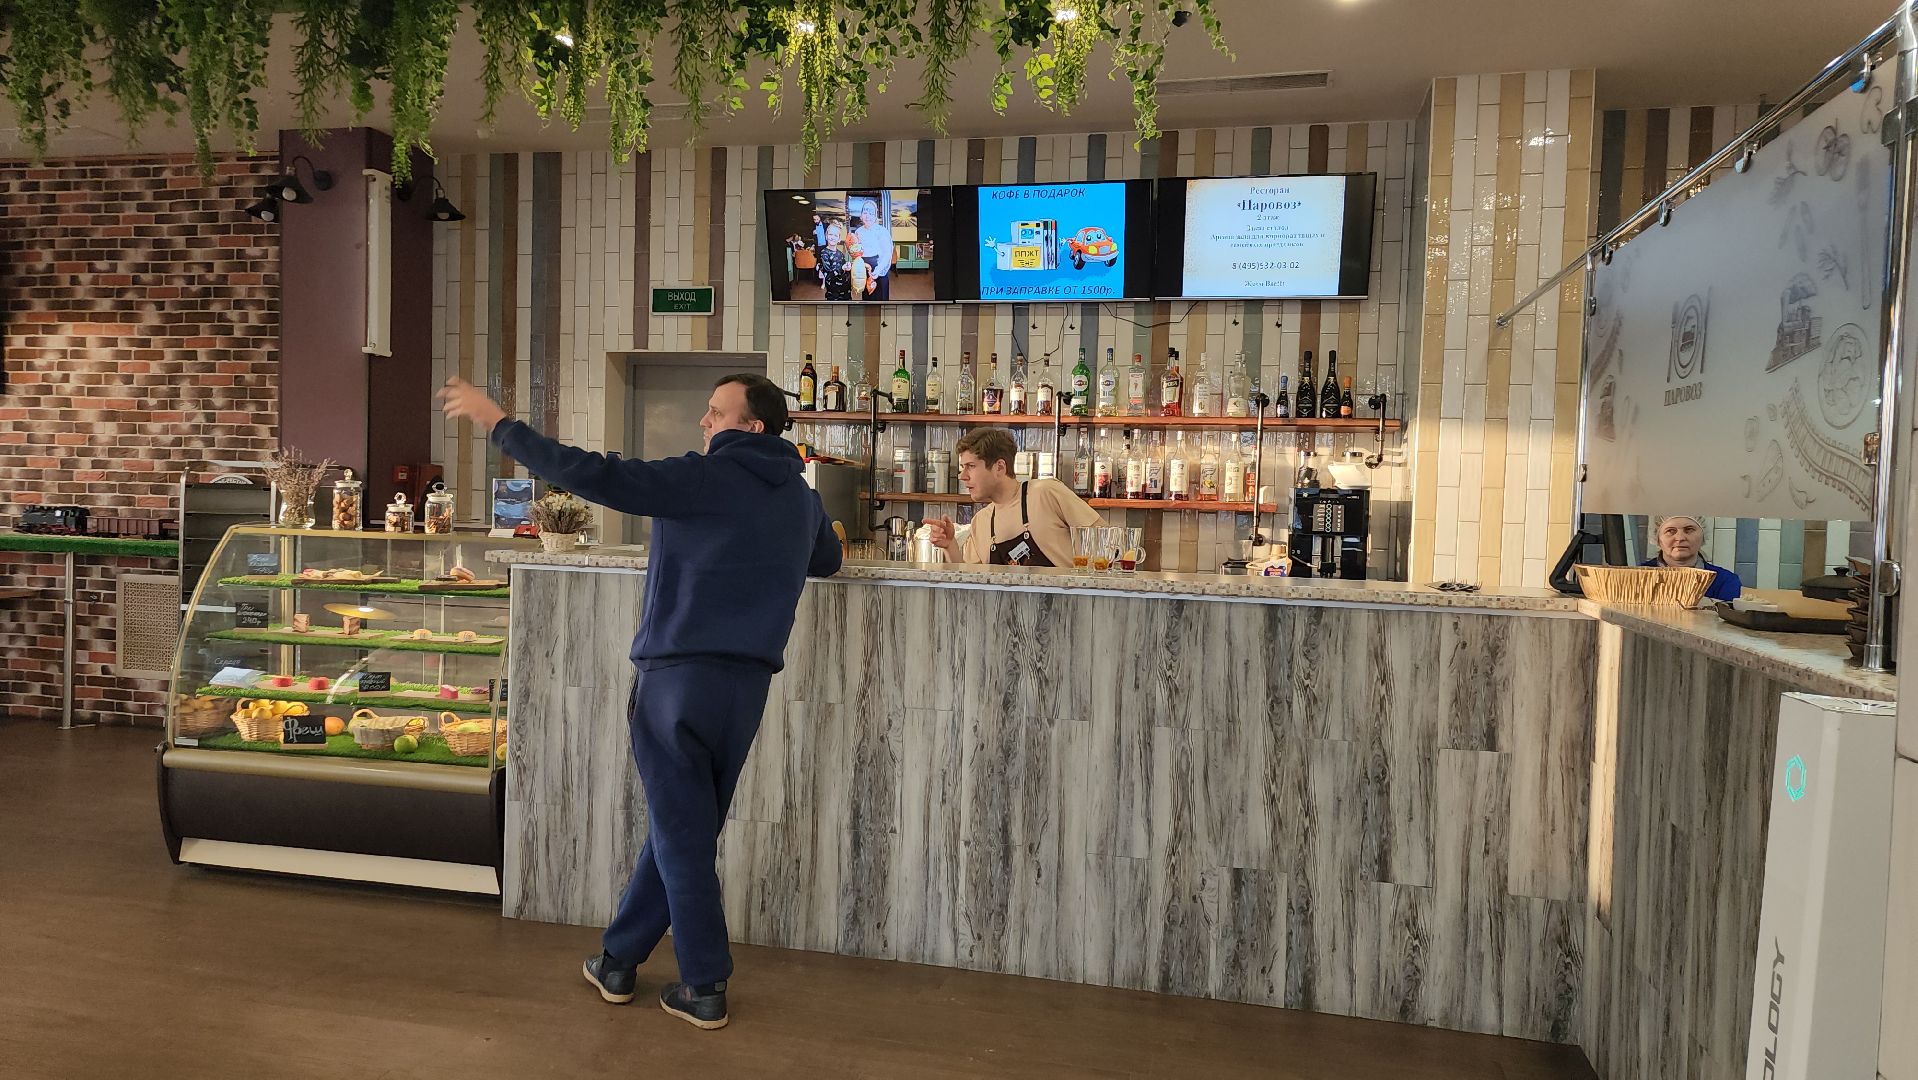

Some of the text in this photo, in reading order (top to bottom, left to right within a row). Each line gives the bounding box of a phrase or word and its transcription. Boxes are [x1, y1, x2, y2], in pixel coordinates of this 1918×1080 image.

[992, 188, 1086, 199] КОФЕ В ПОДАРОК
[1250, 187, 1290, 195] Ресторан
[1014, 249, 1040, 258] ППЖТ
[982, 286, 1004, 296] ПРИ
[1006, 285, 1061, 296] ЗАПРАВКЕ
[1063, 285, 1078, 295] ОТ
[667, 291, 696, 302] ВЫХОД
[1664, 382, 1702, 406] ПАРОВОЗ
